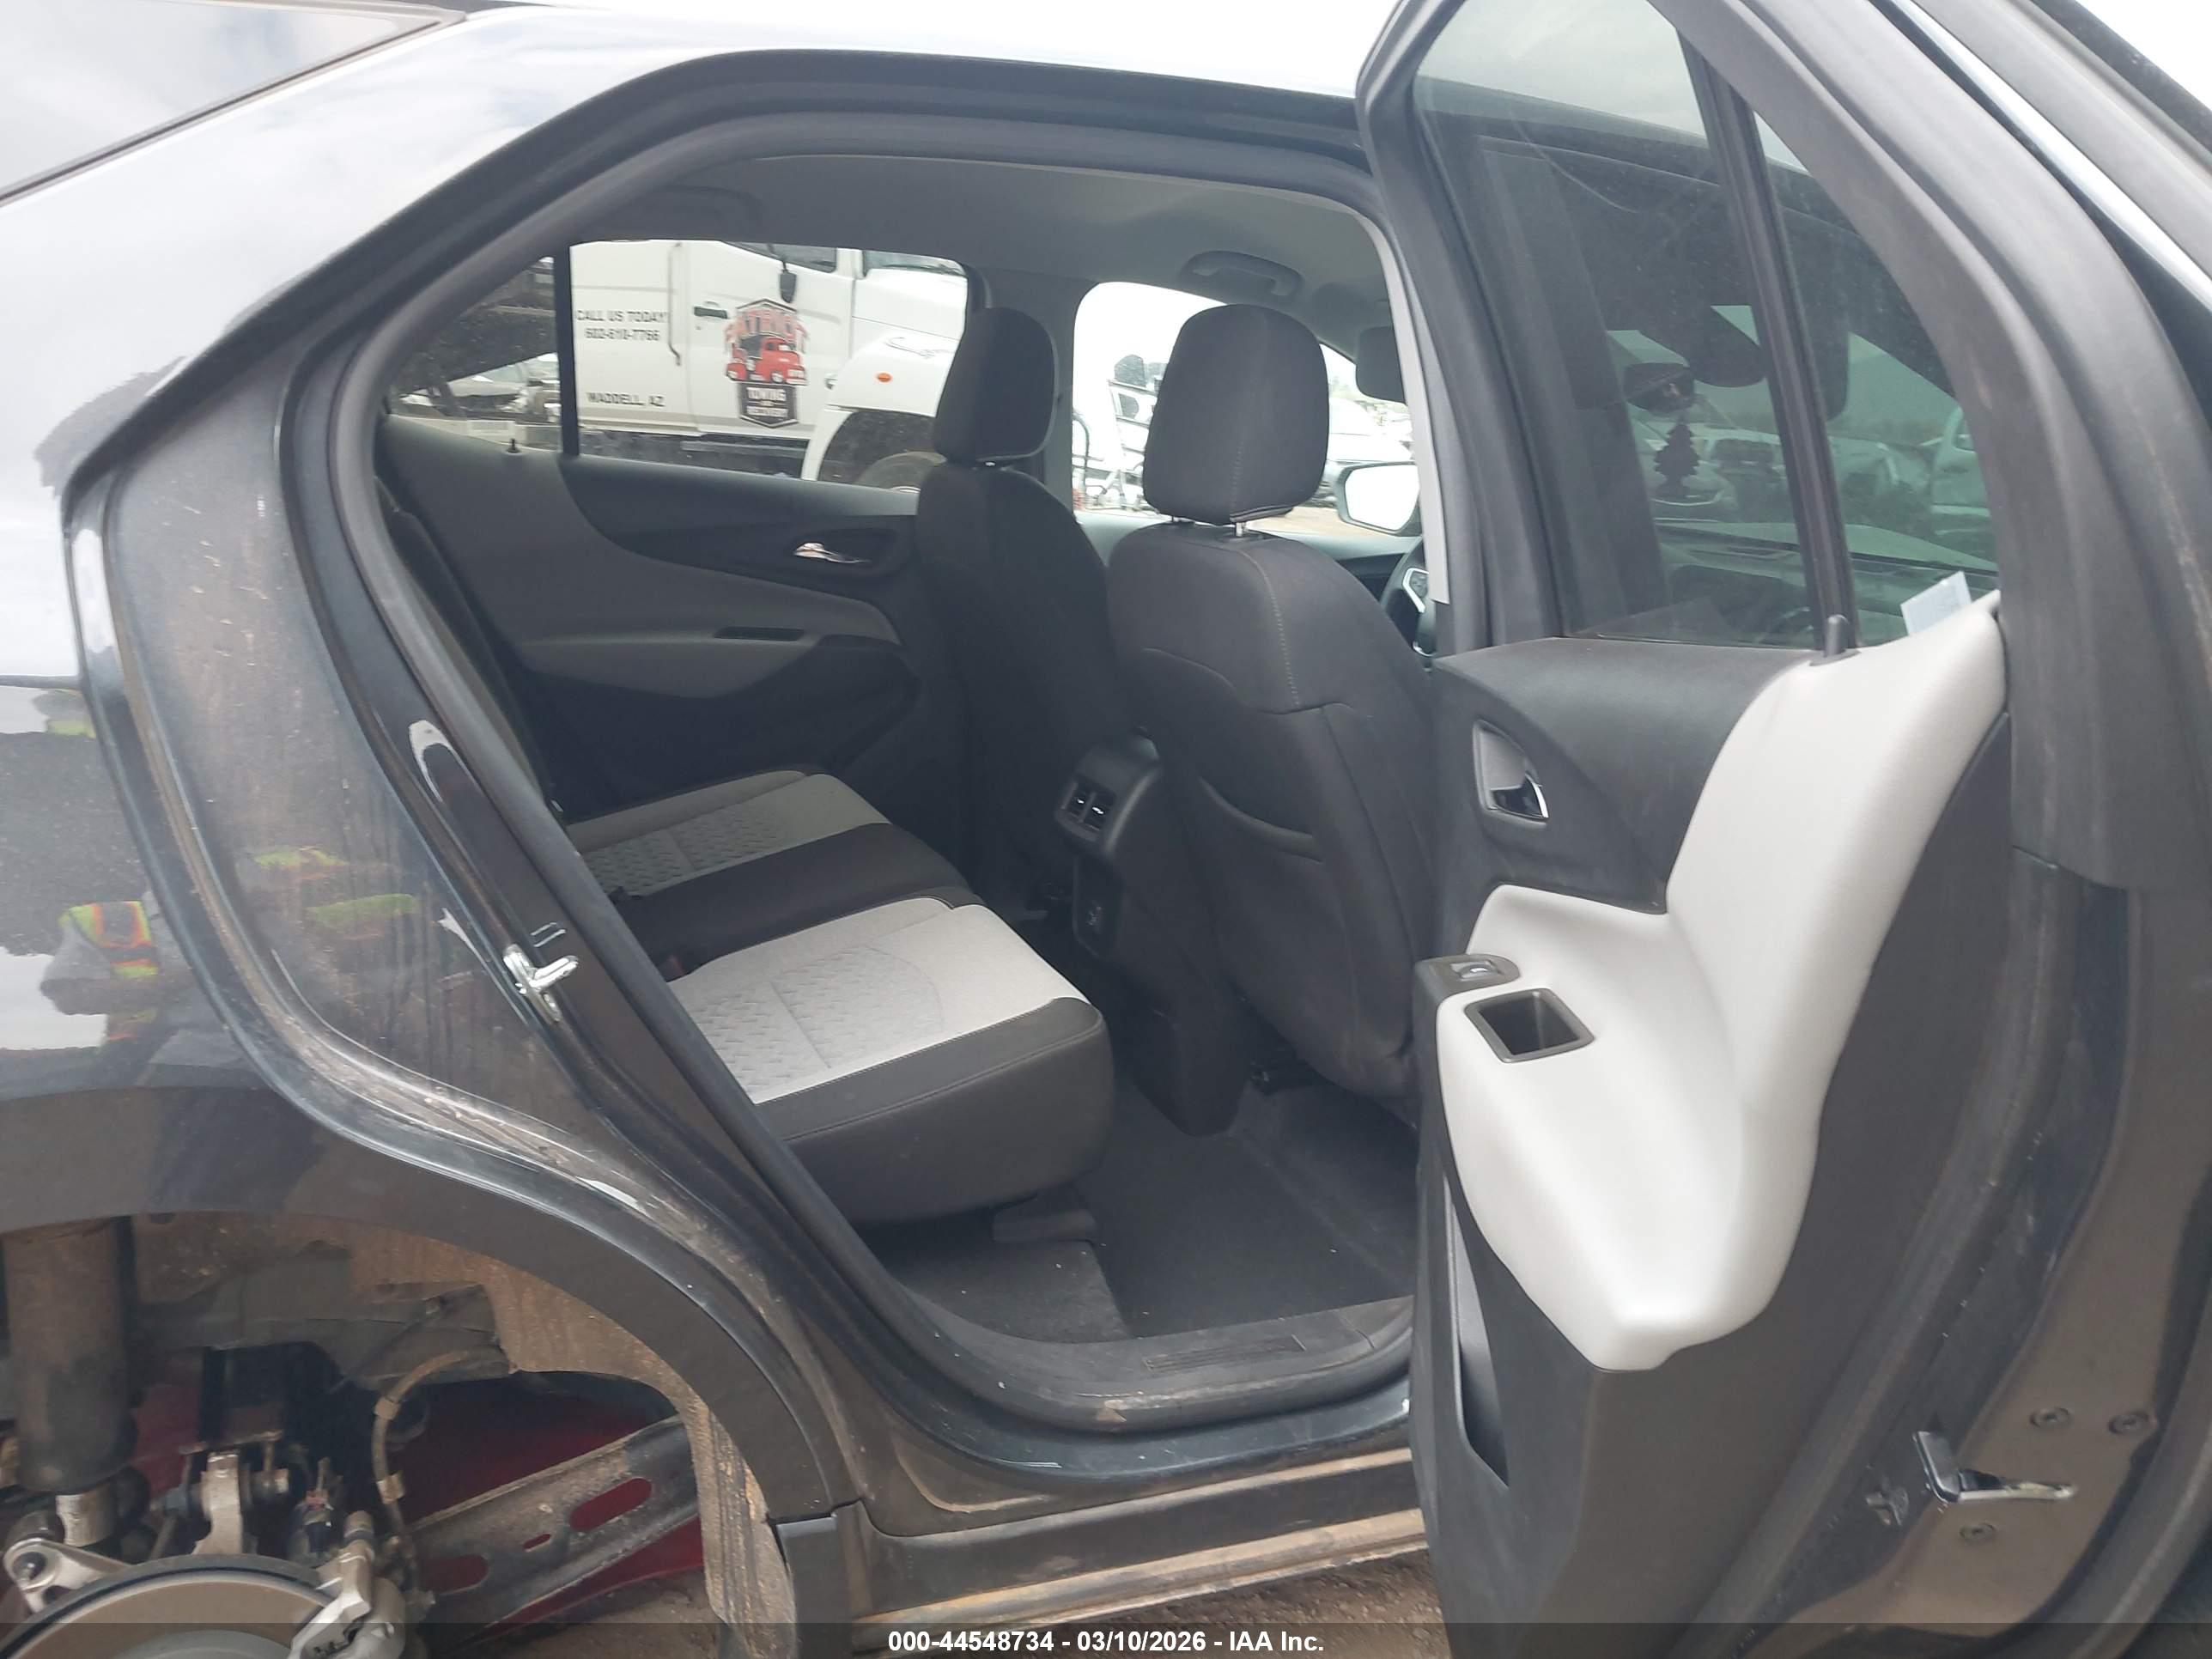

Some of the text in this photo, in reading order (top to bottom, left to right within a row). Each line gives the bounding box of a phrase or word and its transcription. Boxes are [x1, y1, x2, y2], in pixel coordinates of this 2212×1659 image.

[576, 309, 605, 321] CALL
[607, 310, 623, 322] US
[648, 394, 665, 408] AZ
